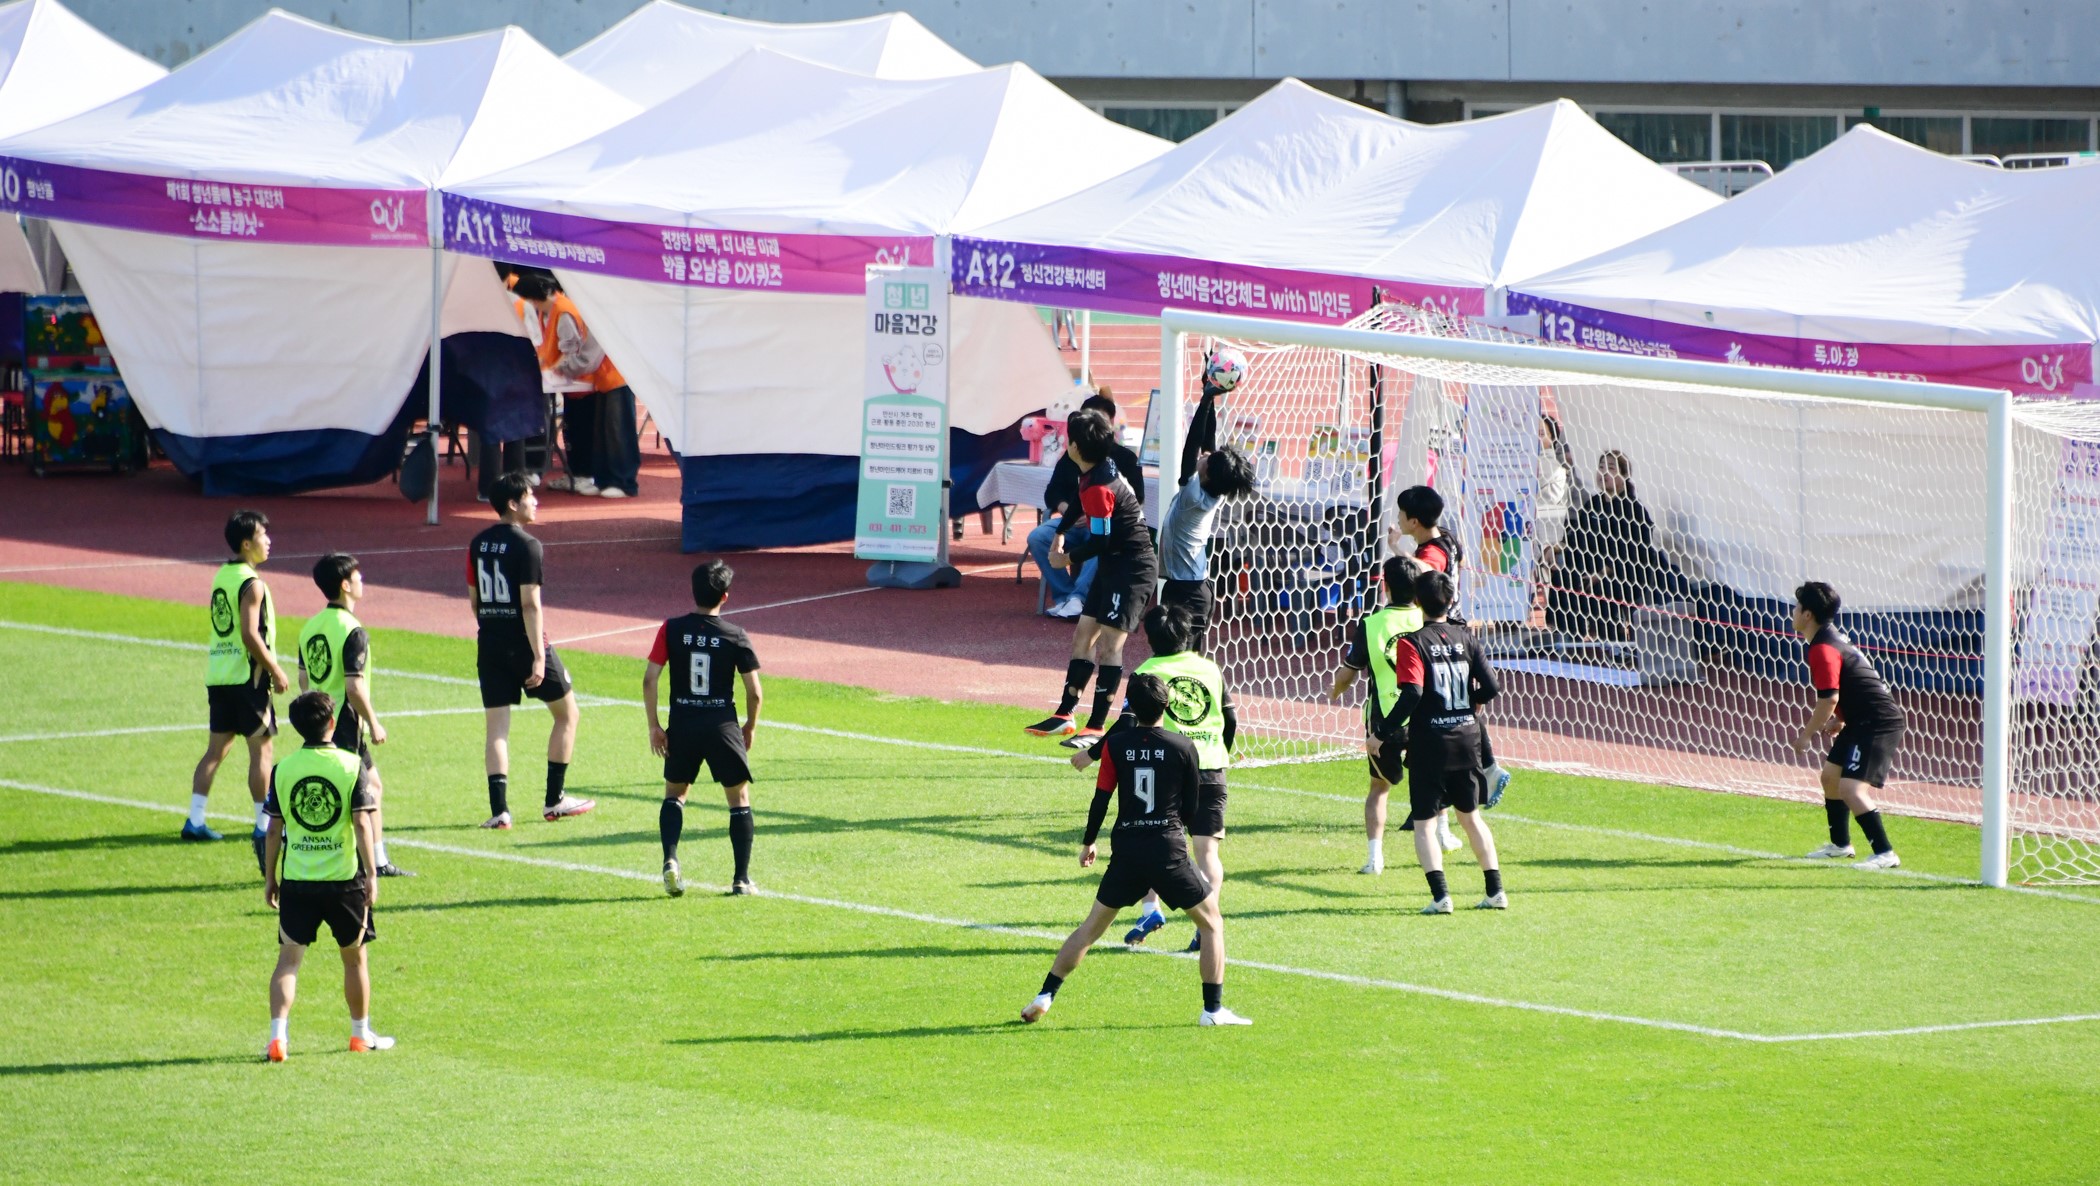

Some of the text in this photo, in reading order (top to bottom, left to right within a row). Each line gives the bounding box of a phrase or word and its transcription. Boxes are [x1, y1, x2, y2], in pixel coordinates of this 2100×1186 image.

[456, 206, 497, 247] A11
[661, 231, 691, 252] 건강한
[721, 234, 734, 255] 더
[734, 235, 757, 257] 나은
[757, 237, 780, 258] 미래
[661, 253, 783, 287] 약물 오남용 OX퀴즈
[965, 248, 1016, 289] A12
[1020, 263, 1106, 291] 정신건강복지센터
[886, 285, 926, 308] 청년
[1157, 271, 1268, 308] 청년마음건강체크
[1270, 287, 1307, 313] with
[874, 313, 938, 336] 마음건강
[477, 557, 511, 603] 66
[690, 651, 711, 696] 8
[1125, 749, 1165, 761] 임지혁
[1133, 767, 1155, 814] 9
[291, 843, 333, 852] GREENERS
[302, 836, 332, 844] ANSAN
